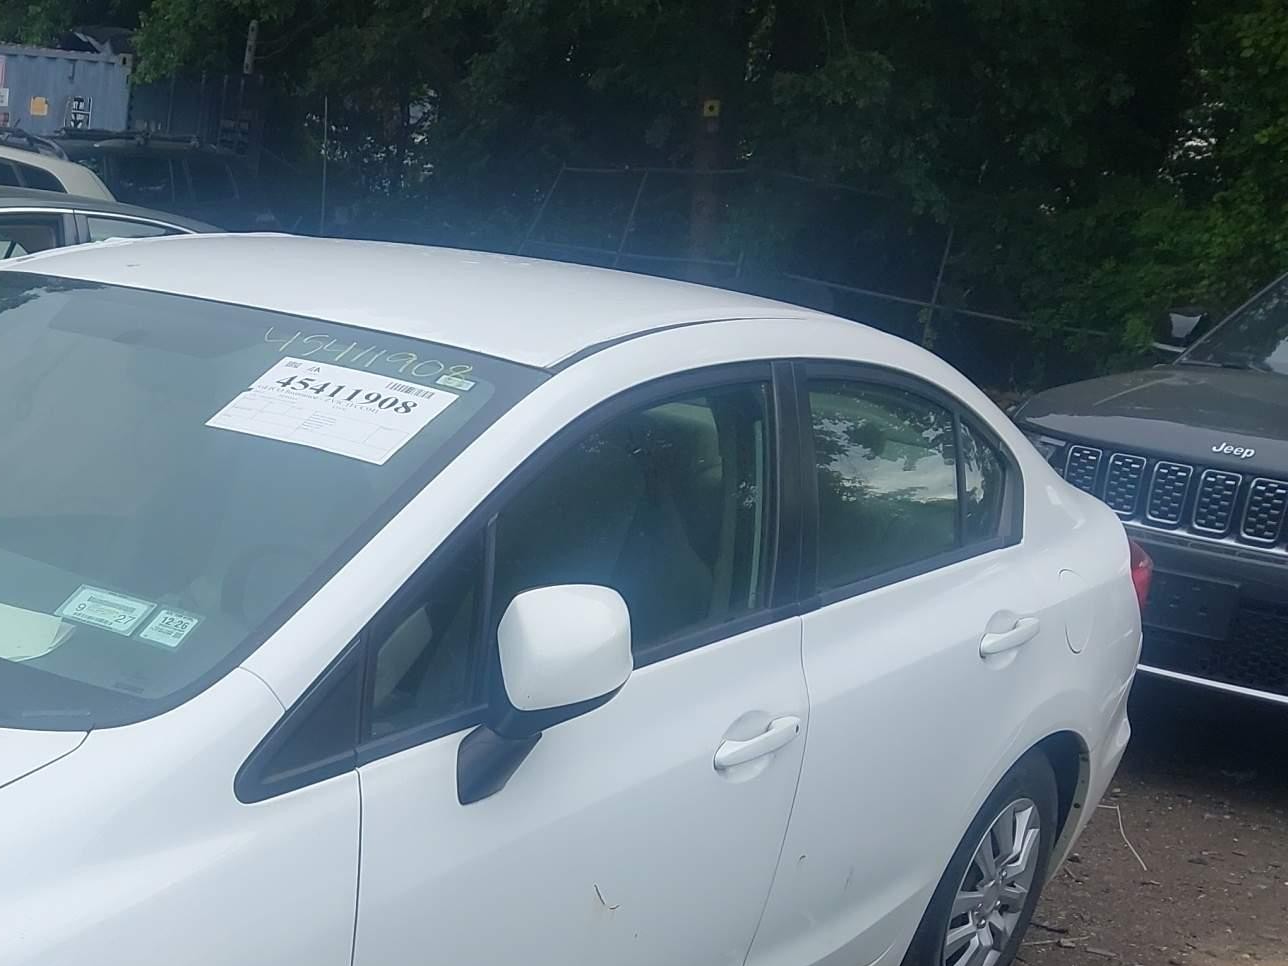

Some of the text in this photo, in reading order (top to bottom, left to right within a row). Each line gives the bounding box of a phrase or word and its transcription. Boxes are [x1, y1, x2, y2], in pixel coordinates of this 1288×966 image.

[275, 375, 418, 415] 45411908
[1212, 442, 1255, 459] Jeep
[75, 602, 87, 612] 9
[114, 614, 137, 625] 27
